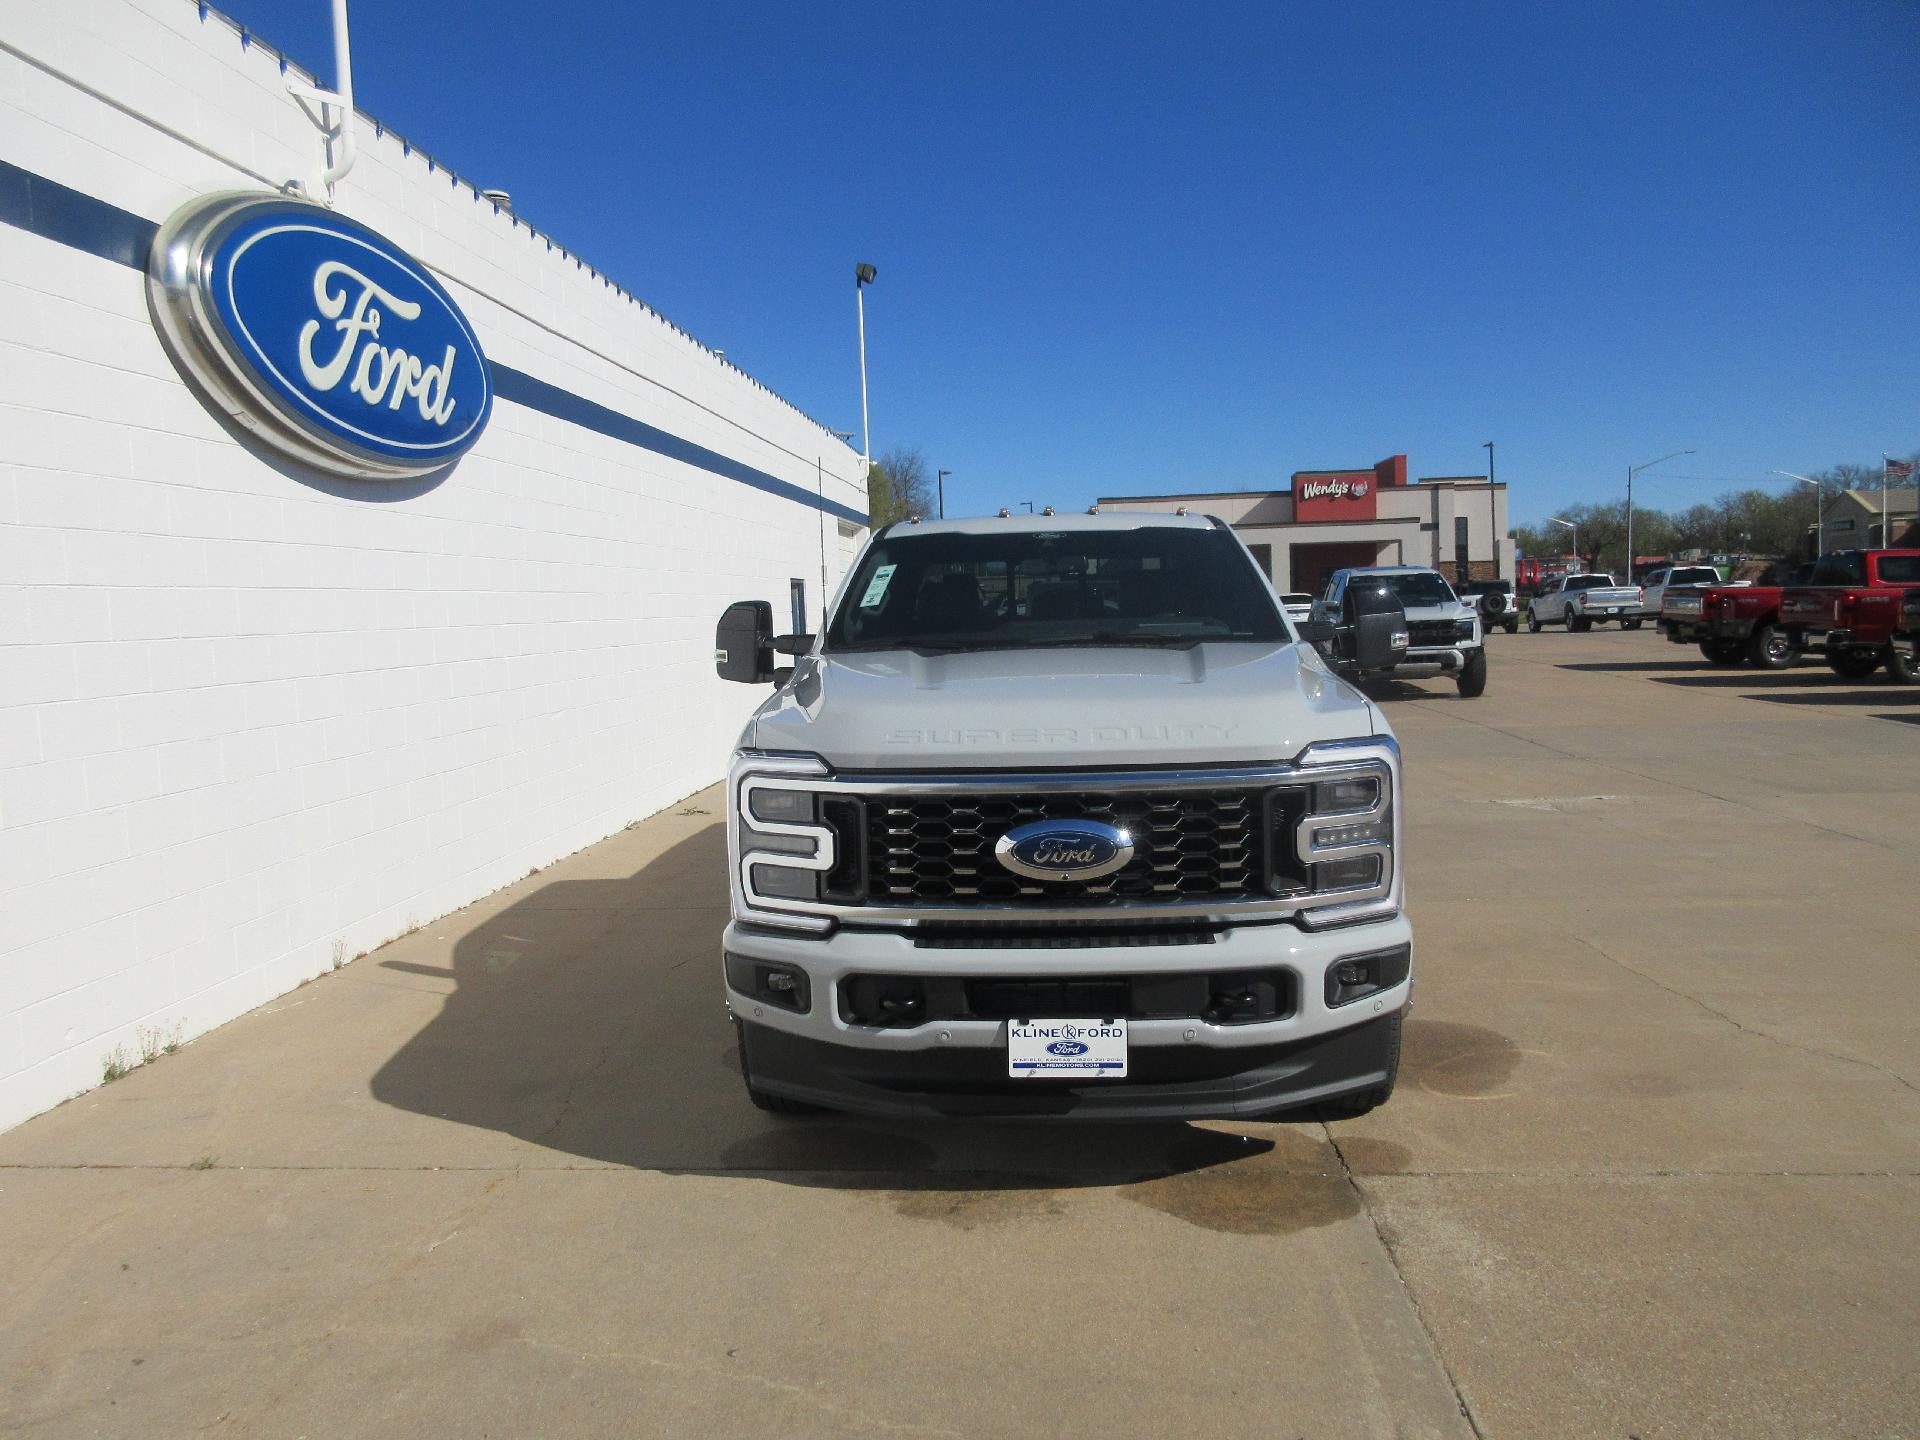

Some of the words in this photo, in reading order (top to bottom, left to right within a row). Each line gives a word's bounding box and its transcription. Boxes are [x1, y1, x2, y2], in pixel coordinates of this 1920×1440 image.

[298, 260, 457, 427] Ford
[1303, 478, 1349, 500] Wendy's
[884, 728, 1080, 745] SUPER
[1090, 723, 1240, 743] DUTY
[1033, 837, 1097, 863] Ford
[1011, 1028, 1060, 1038] KLINE
[1077, 1028, 1123, 1038] FORD
[1053, 1042, 1081, 1054] Ford
